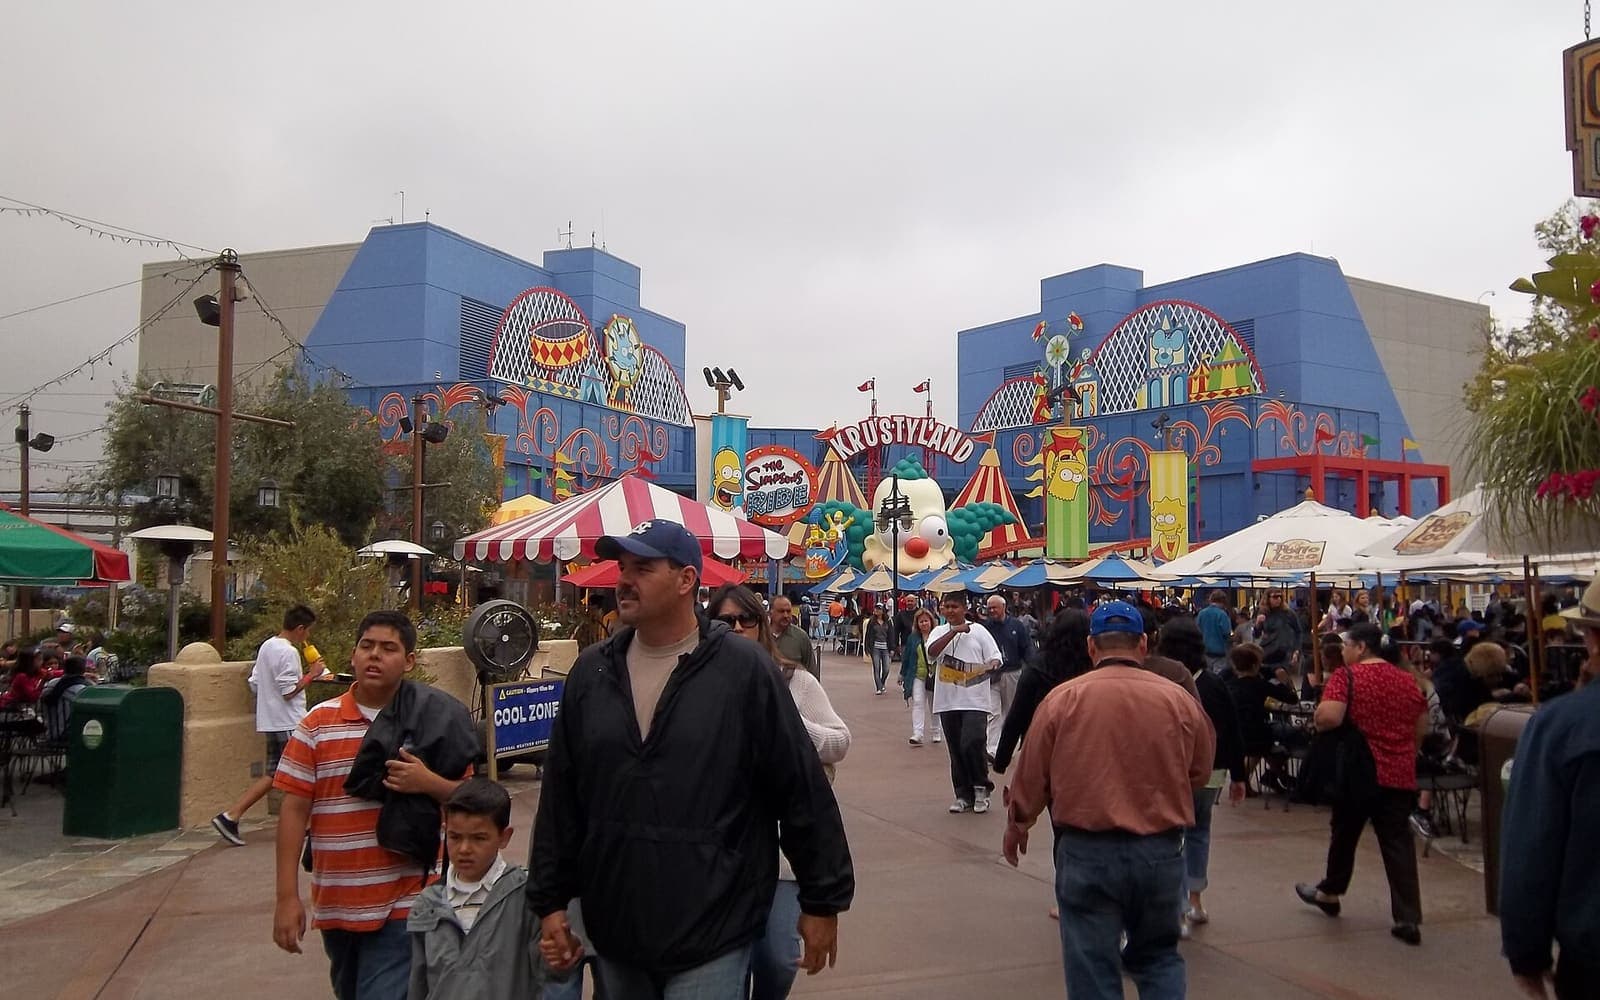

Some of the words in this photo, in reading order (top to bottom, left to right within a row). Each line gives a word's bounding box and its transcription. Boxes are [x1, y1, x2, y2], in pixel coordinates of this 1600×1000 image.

[829, 415, 975, 463] KRUSTYLAND
[762, 459, 785, 472] THE
[746, 484, 809, 520] RIDE
[494, 706, 527, 727] COOL
[529, 701, 560, 722] ZONE
